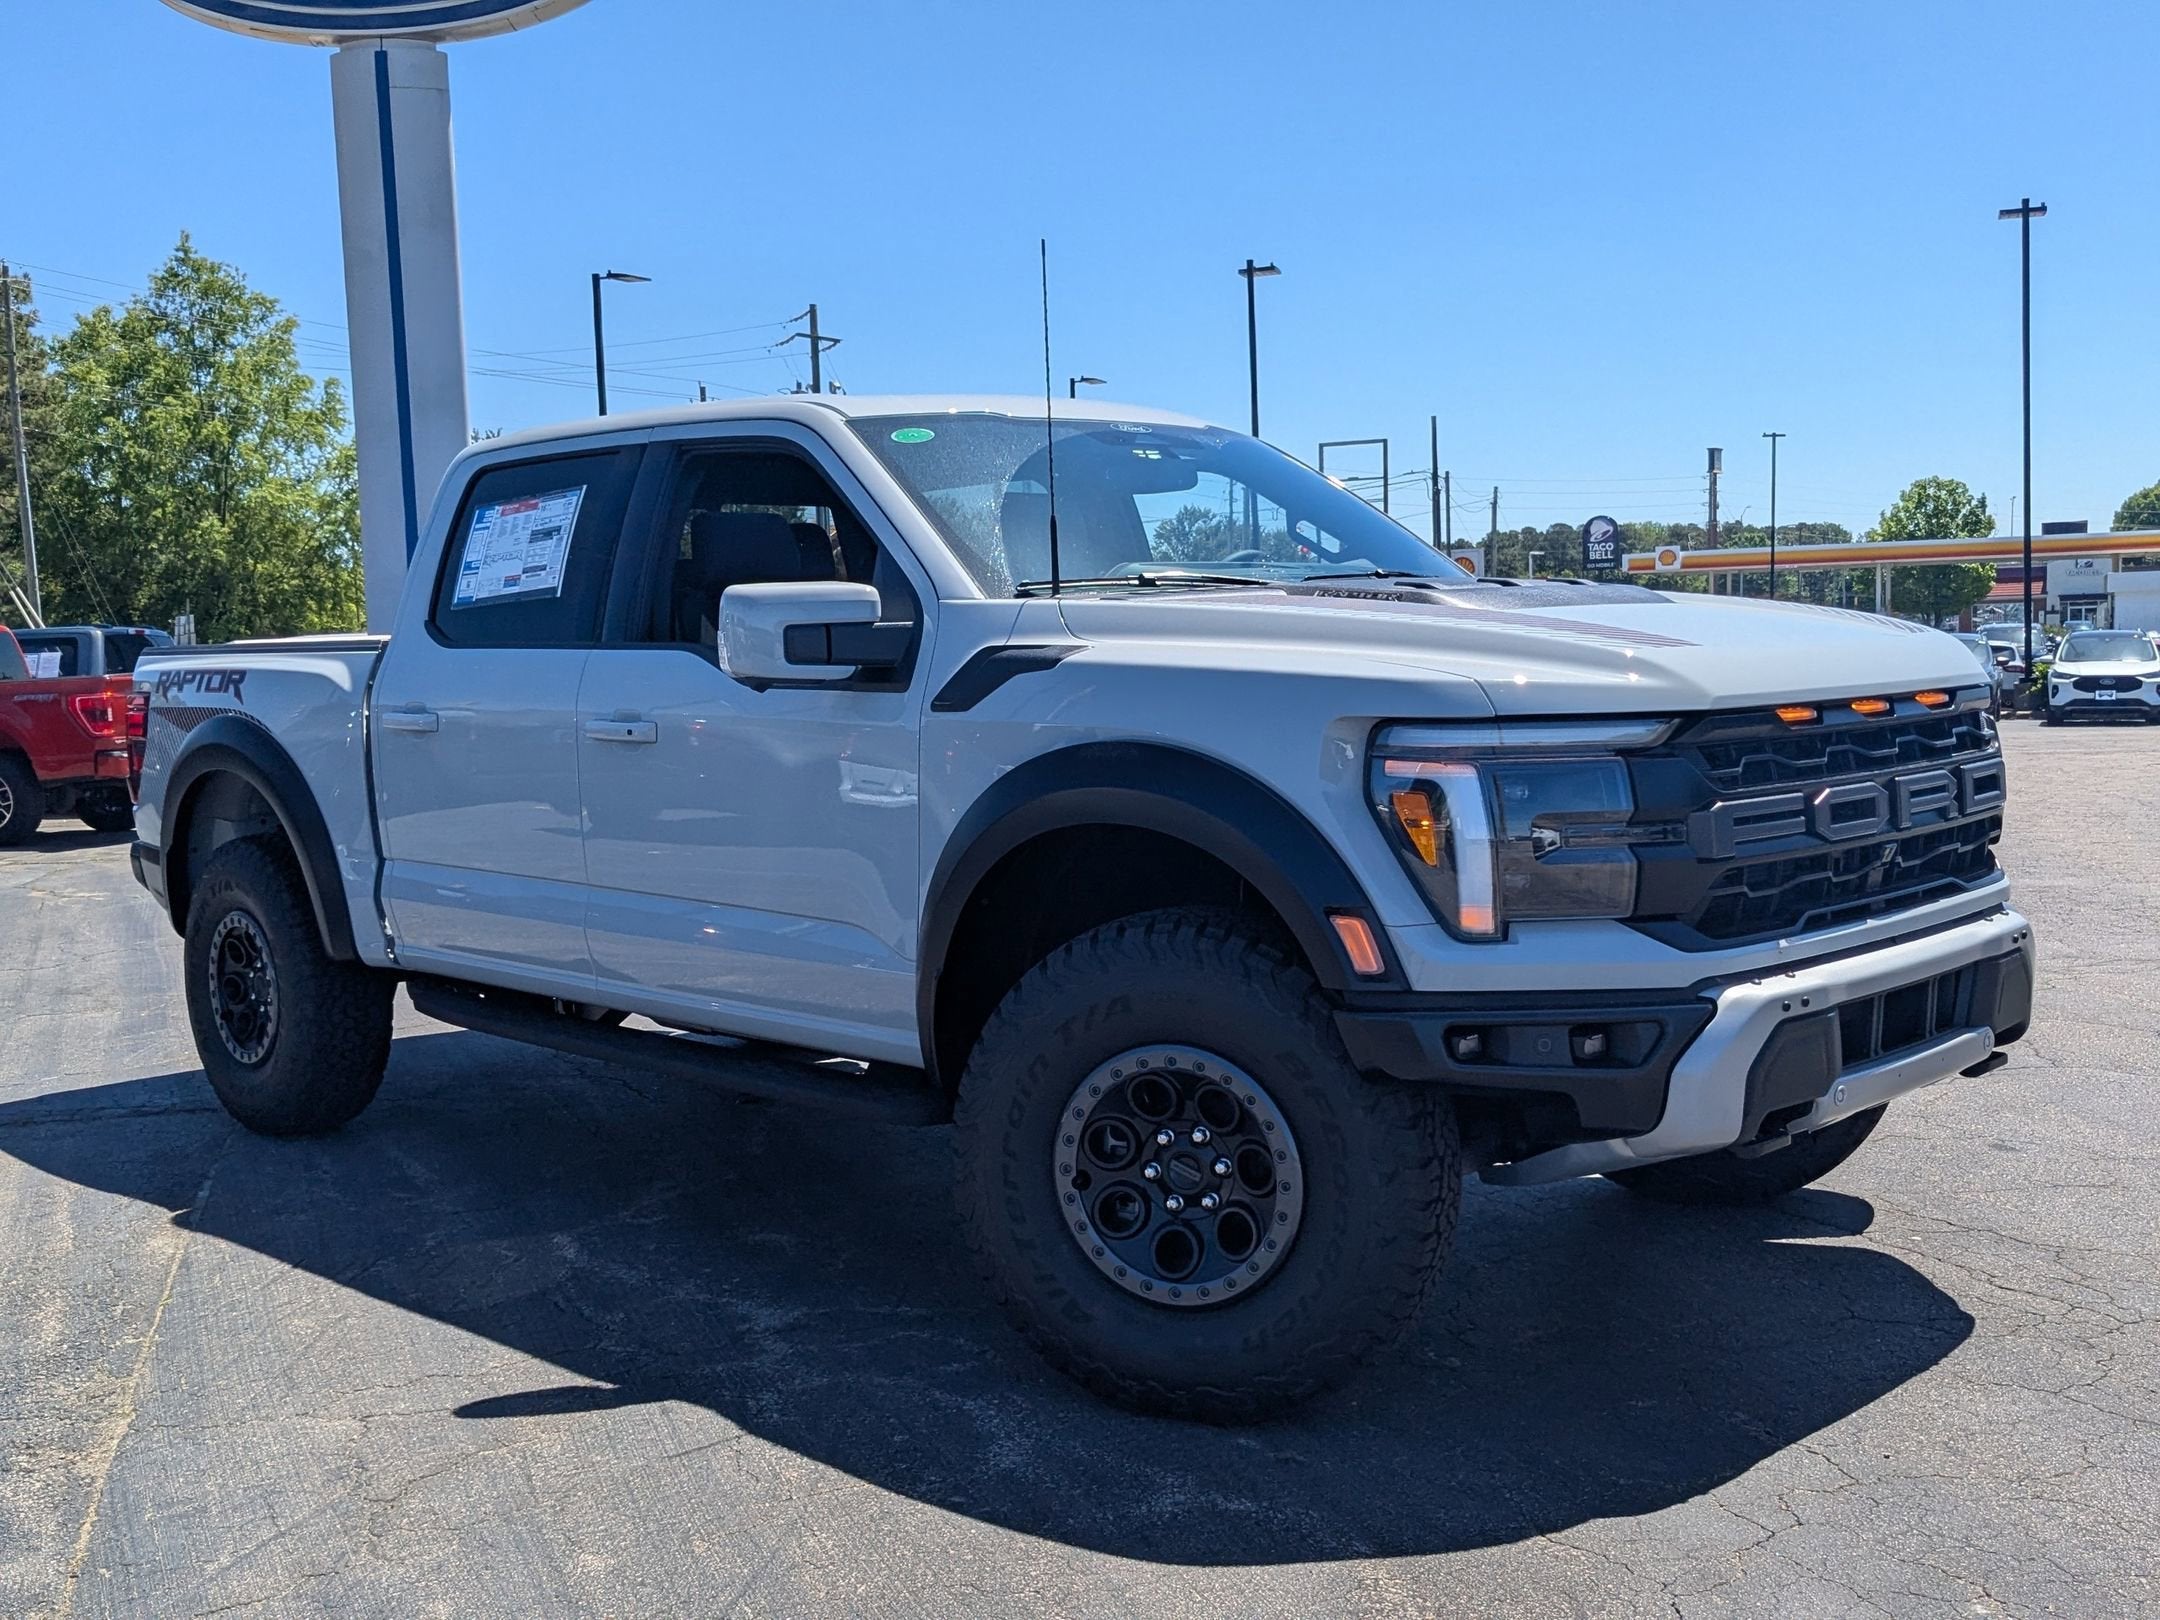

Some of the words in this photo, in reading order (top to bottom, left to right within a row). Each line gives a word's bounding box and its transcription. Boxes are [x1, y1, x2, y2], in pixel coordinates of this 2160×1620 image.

[1587, 542, 1614, 551] TACO
[1589, 551, 1614, 560] BELL
[155, 670, 247, 706] RAPTOR
[1688, 757, 2006, 863] FORD
[1053, 995, 1132, 1047] T/A
